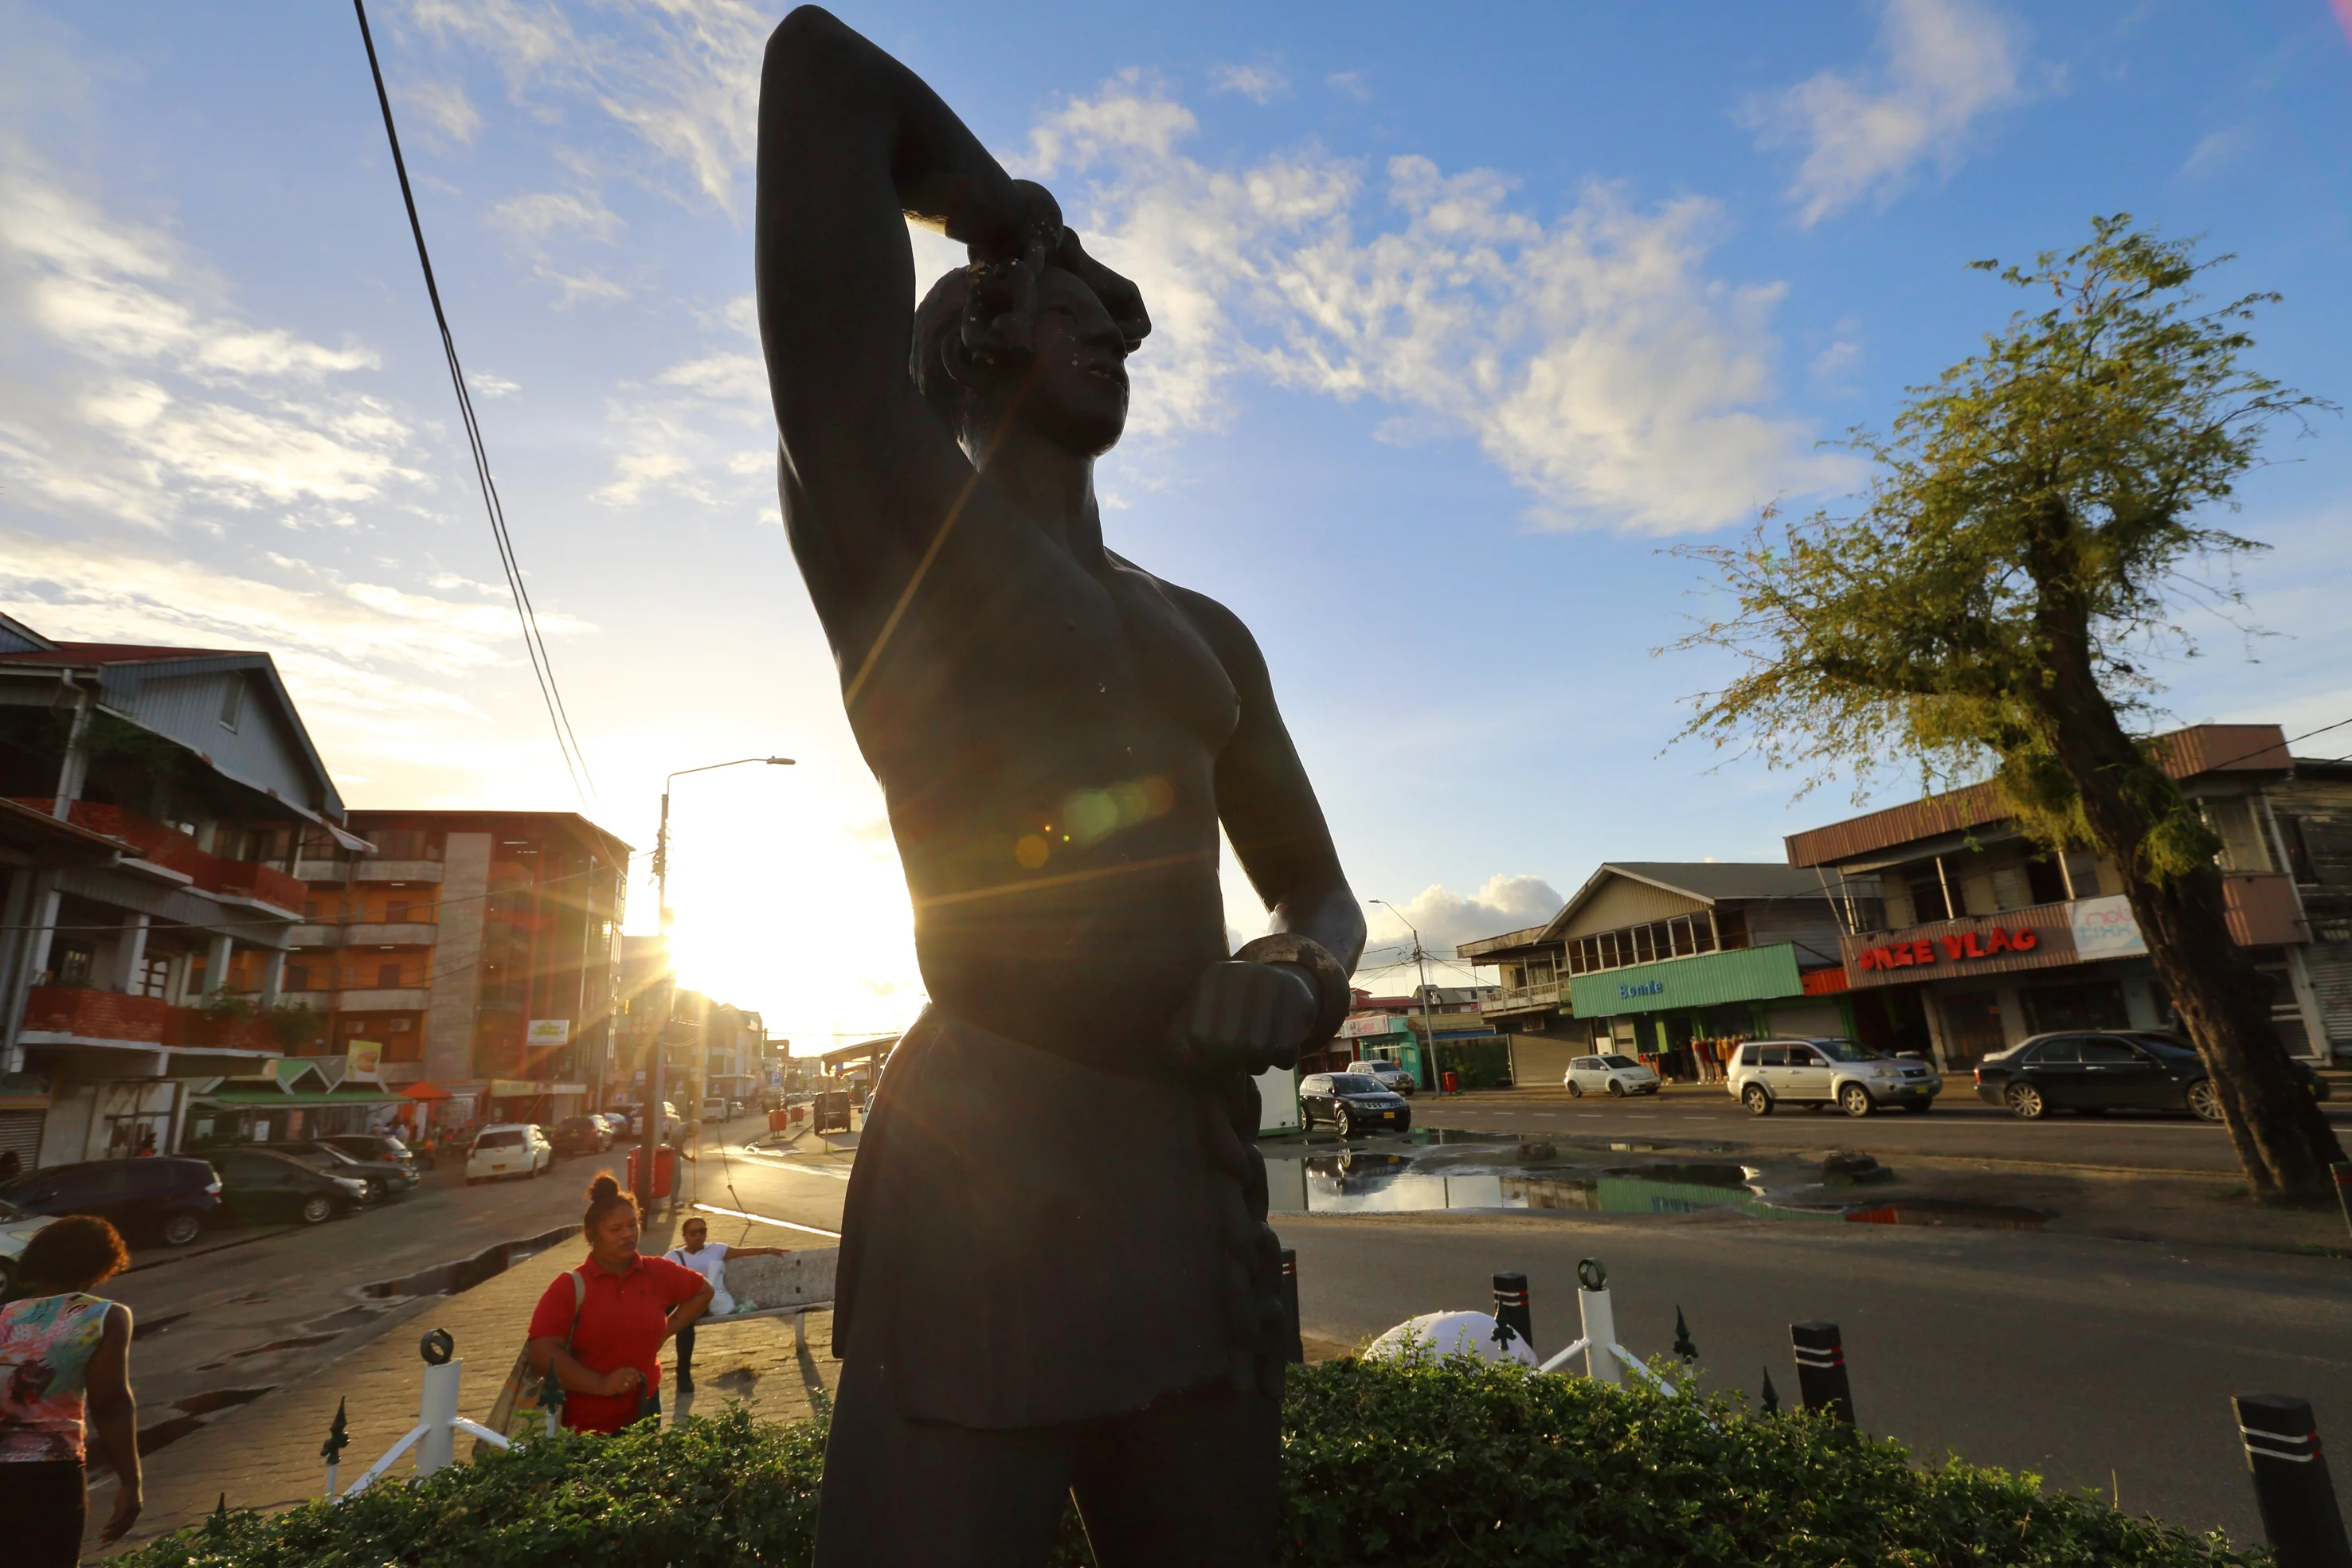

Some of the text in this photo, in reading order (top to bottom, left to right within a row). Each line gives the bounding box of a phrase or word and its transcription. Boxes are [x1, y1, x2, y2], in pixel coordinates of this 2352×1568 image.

[1860, 926, 2037, 970] ONZE VLAG
[1618, 980, 1663, 999] Bonnie
